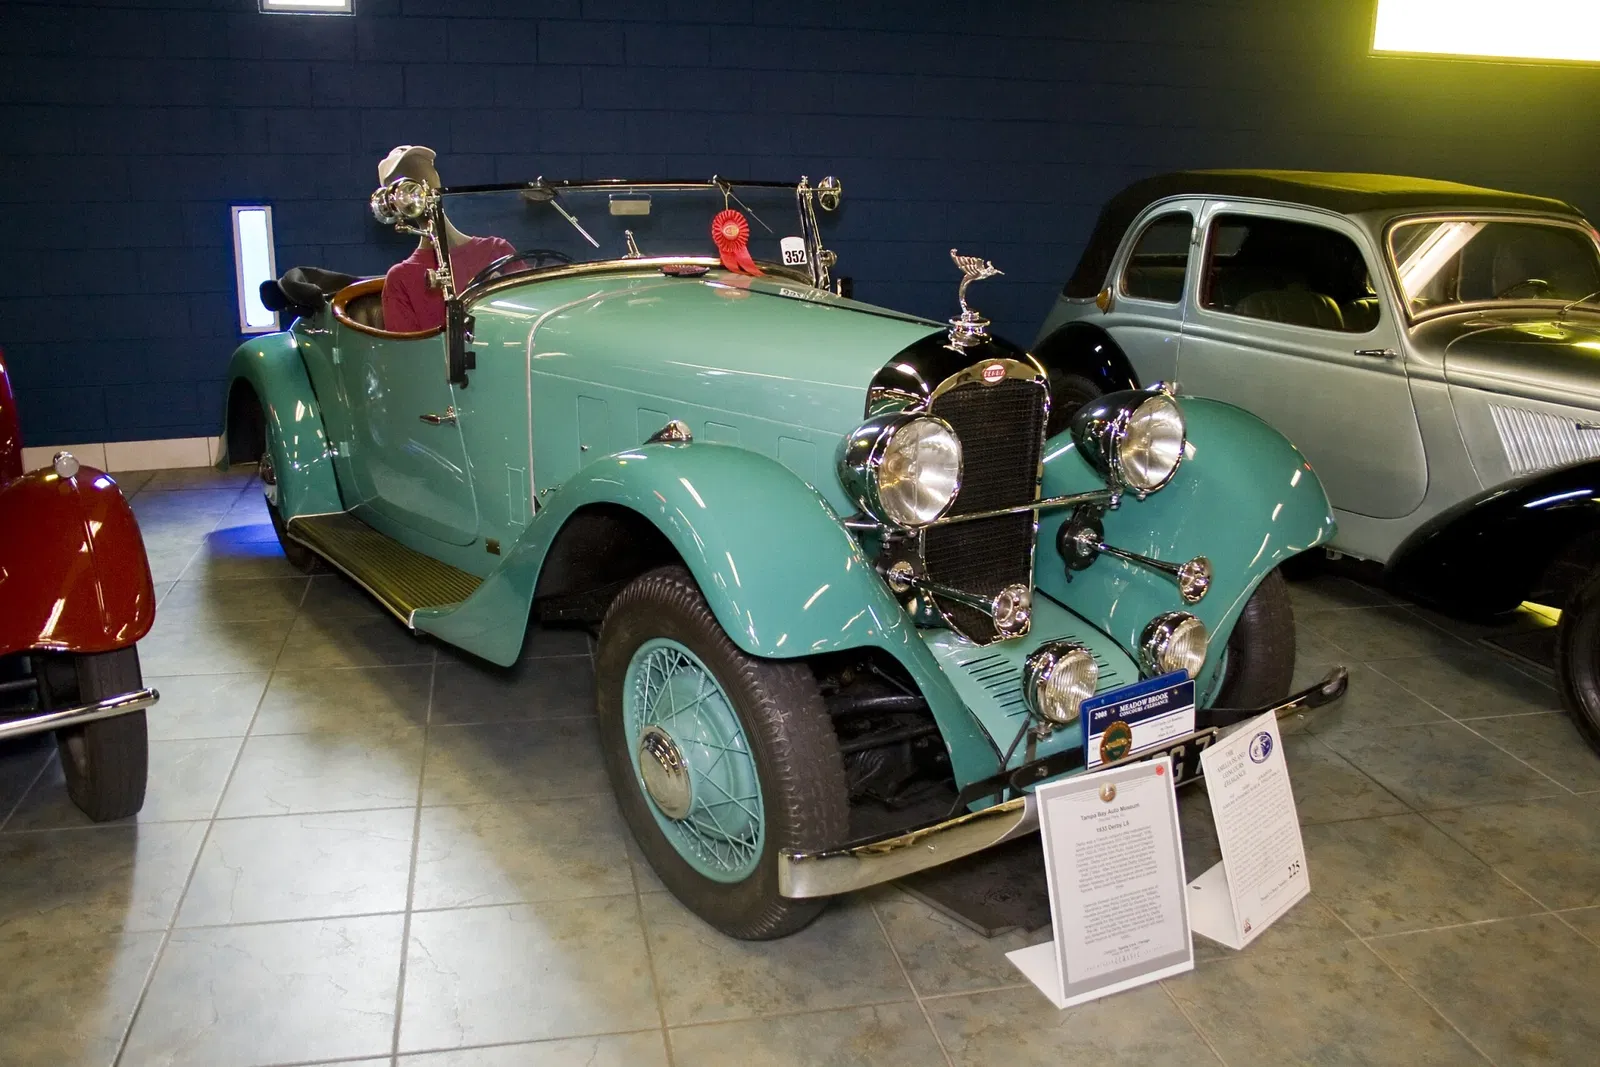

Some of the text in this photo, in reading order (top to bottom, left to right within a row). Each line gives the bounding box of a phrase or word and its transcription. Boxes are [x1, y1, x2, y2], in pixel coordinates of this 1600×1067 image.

[784, 249, 806, 264] 352
[1119, 692, 1169, 713] MEADOW BROOK
[1080, 813, 1097, 821] Tampa
[1119, 803, 1140, 812] Museum
[1108, 822, 1122, 831] Derby
[1287, 859, 1301, 879] 225
